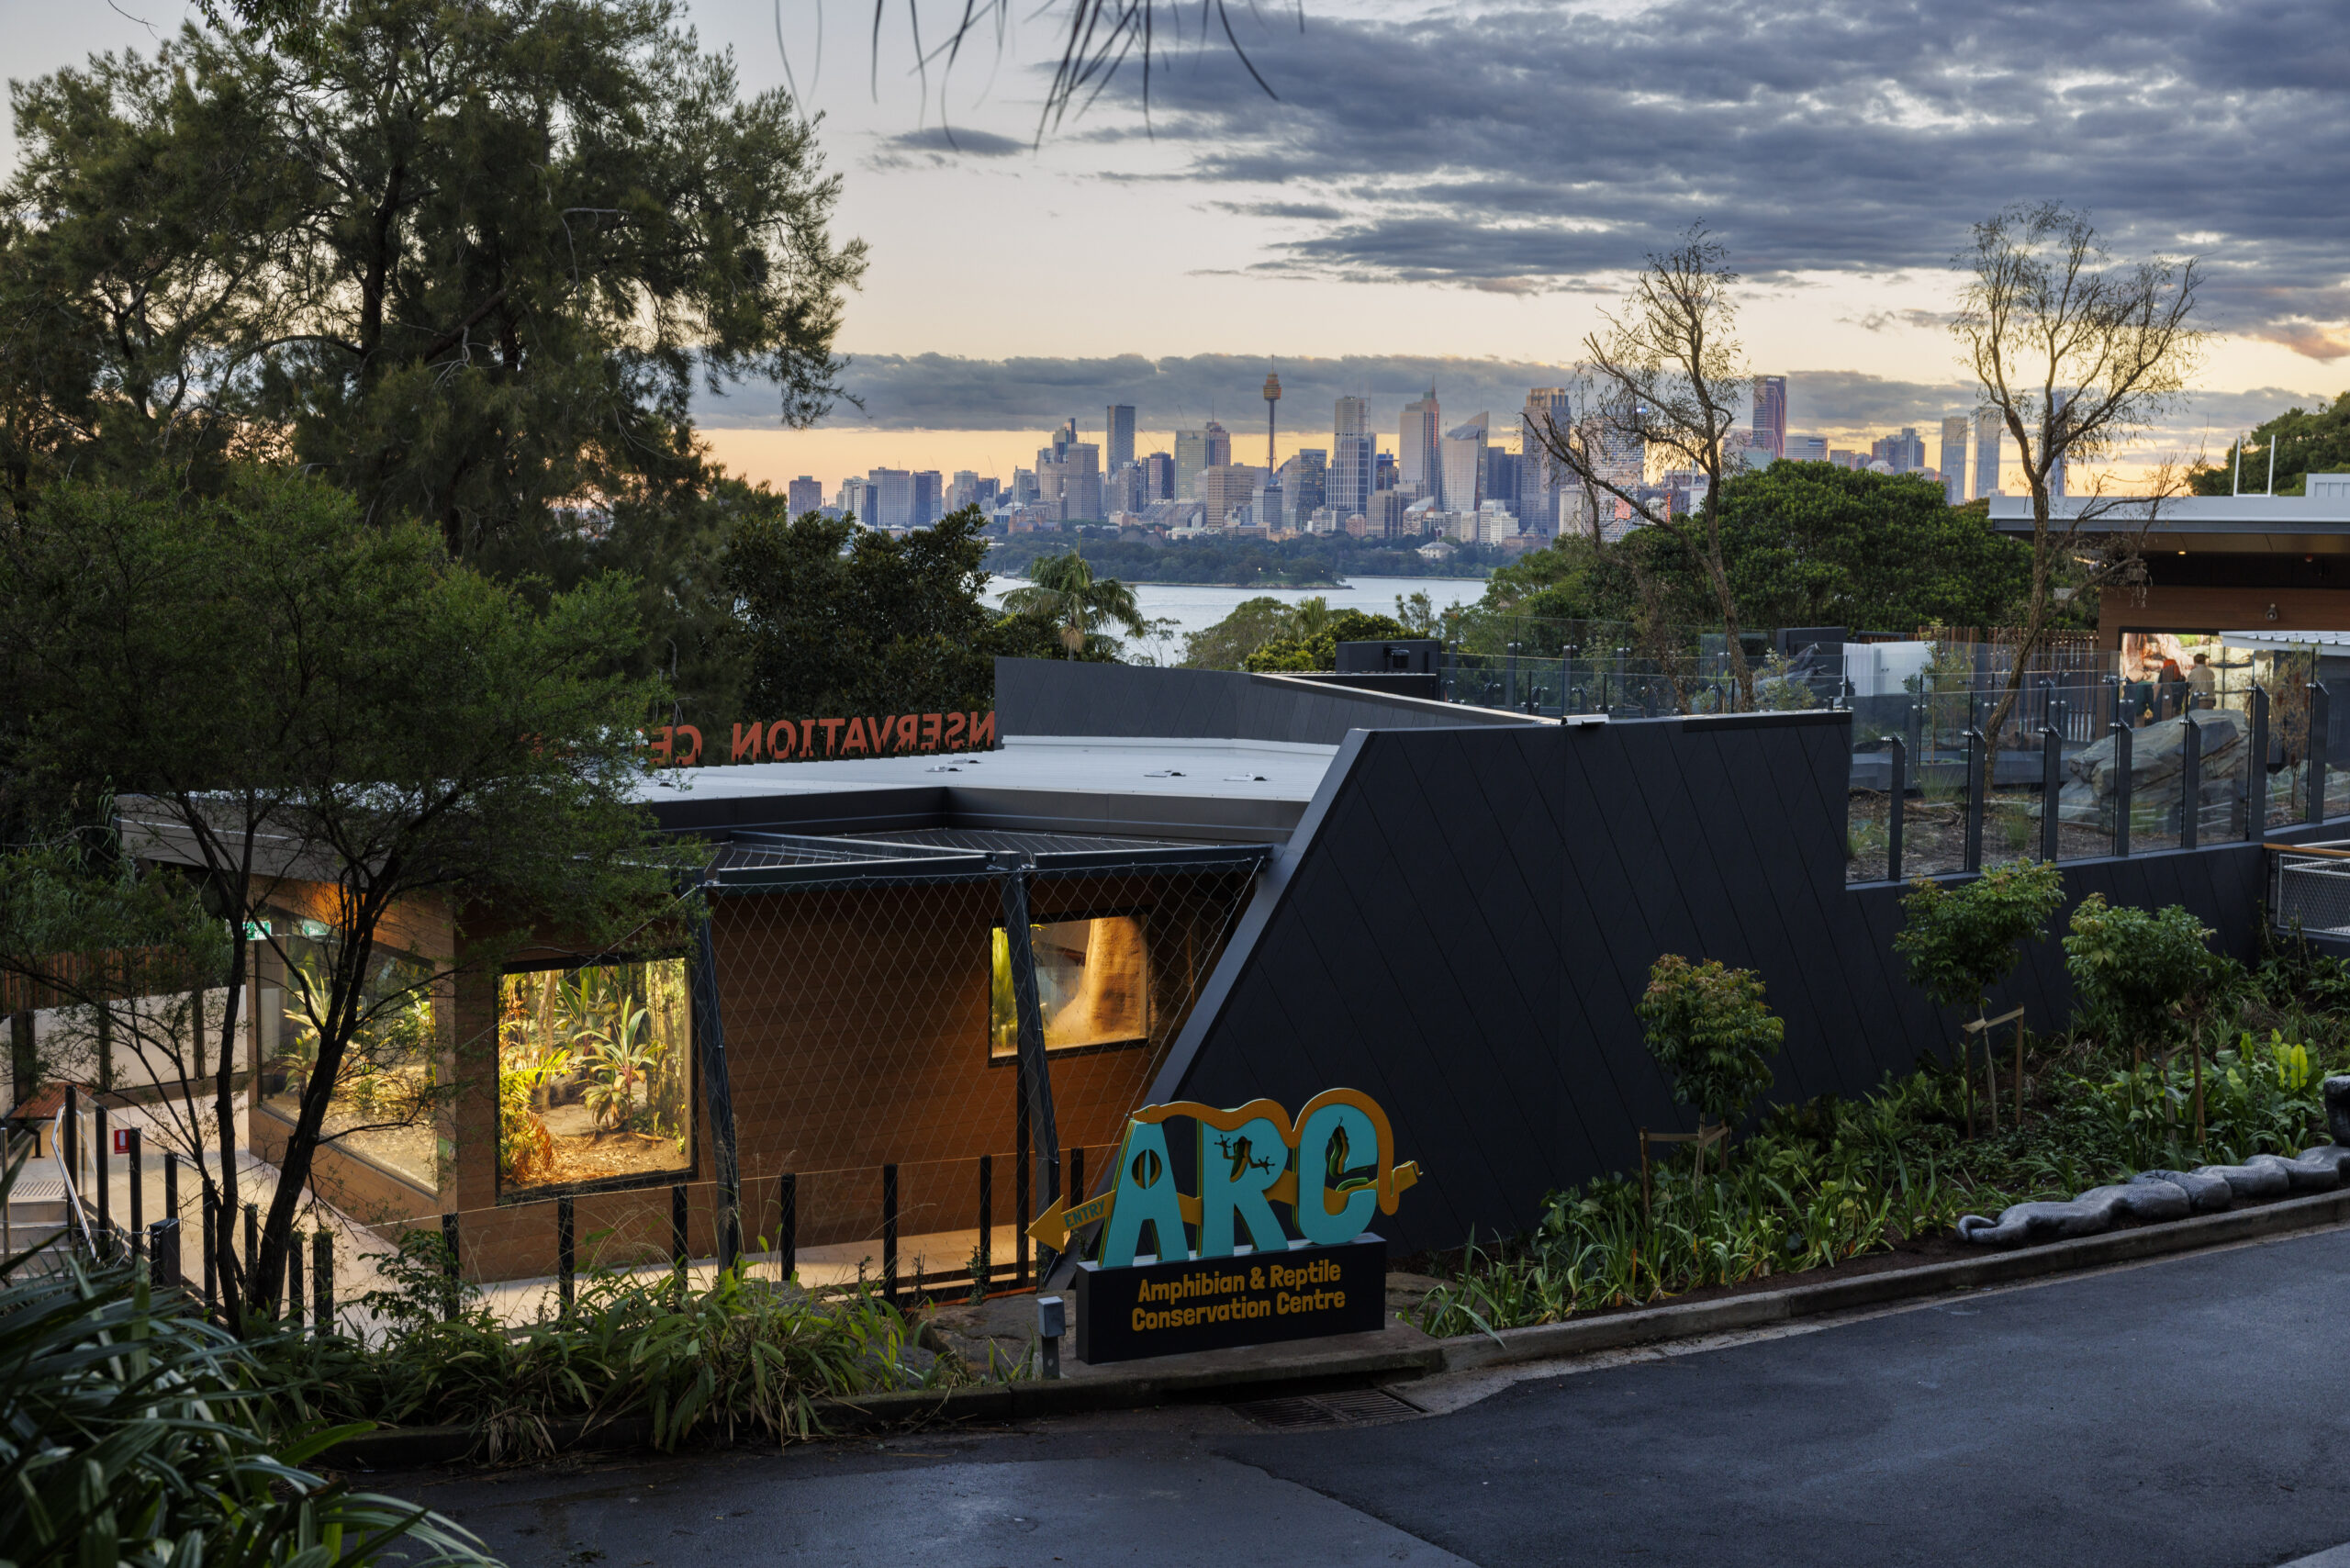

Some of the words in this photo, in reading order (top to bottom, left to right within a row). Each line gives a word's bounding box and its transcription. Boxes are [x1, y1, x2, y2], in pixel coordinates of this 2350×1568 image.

[1100, 1102, 1378, 1268] ARC
[1063, 1199, 1105, 1228] ENTRY
[1137, 1271, 1245, 1305] Amphibian
[1249, 1266, 1265, 1290] &
[1270, 1259, 1341, 1291] Reptile
[1132, 1295, 1270, 1331] Conservation
[1276, 1288, 1346, 1315] Centre
